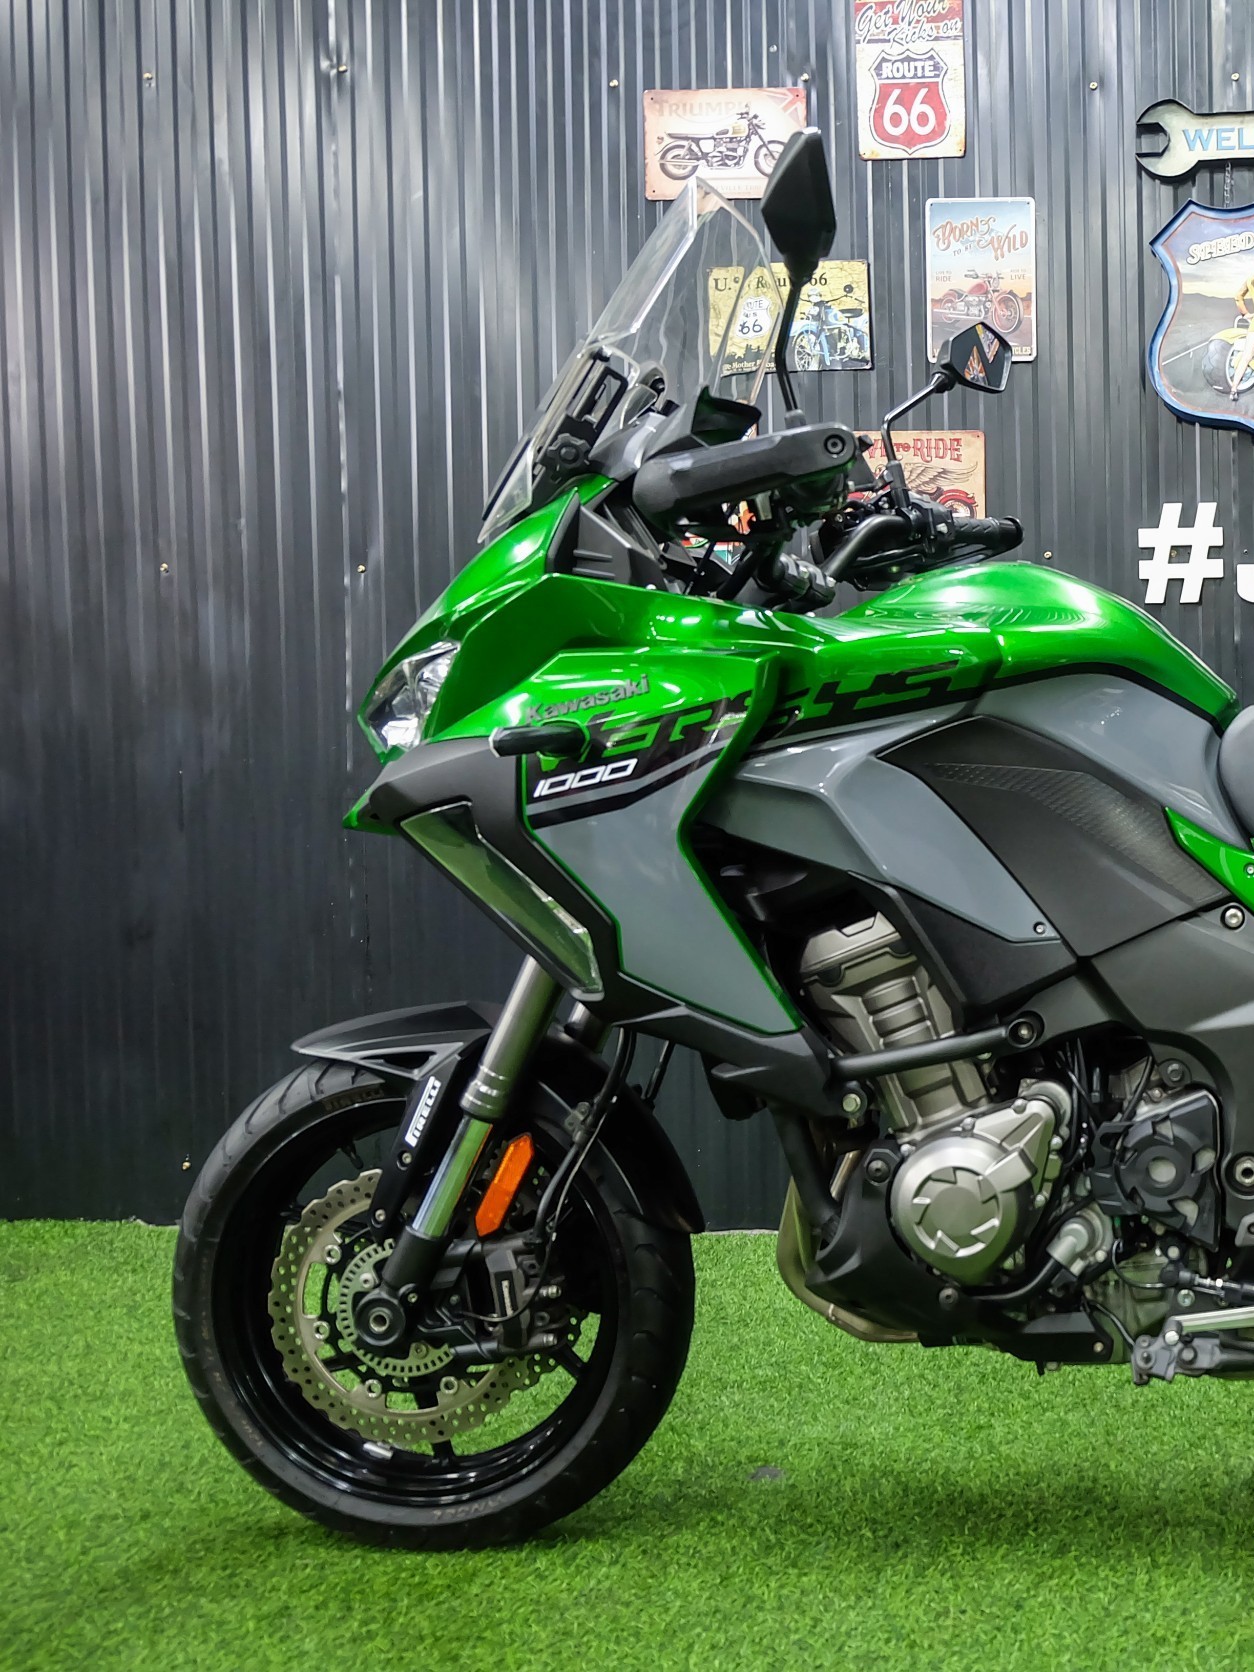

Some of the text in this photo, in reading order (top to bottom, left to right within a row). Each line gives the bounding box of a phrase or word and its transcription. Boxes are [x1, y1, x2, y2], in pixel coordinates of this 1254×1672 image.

[857, 4, 892, 44] Get
[887, 19, 960, 49] Kicks on
[881, 61, 935, 79] ROUTE
[653, 100, 750, 118] TRIUMPH
[883, 88, 936, 136] 66
[932, 216, 996, 251] BORN
[977, 224, 1029, 261] WILD
[739, 319, 763, 335] 66
[893, 442, 911, 453] TO
[913, 438, 962, 463] RIDE
[526, 673, 650, 722] Kawasaki
[533, 757, 638, 798] 1000
[405, 1076, 441, 1147] PIRELLI
